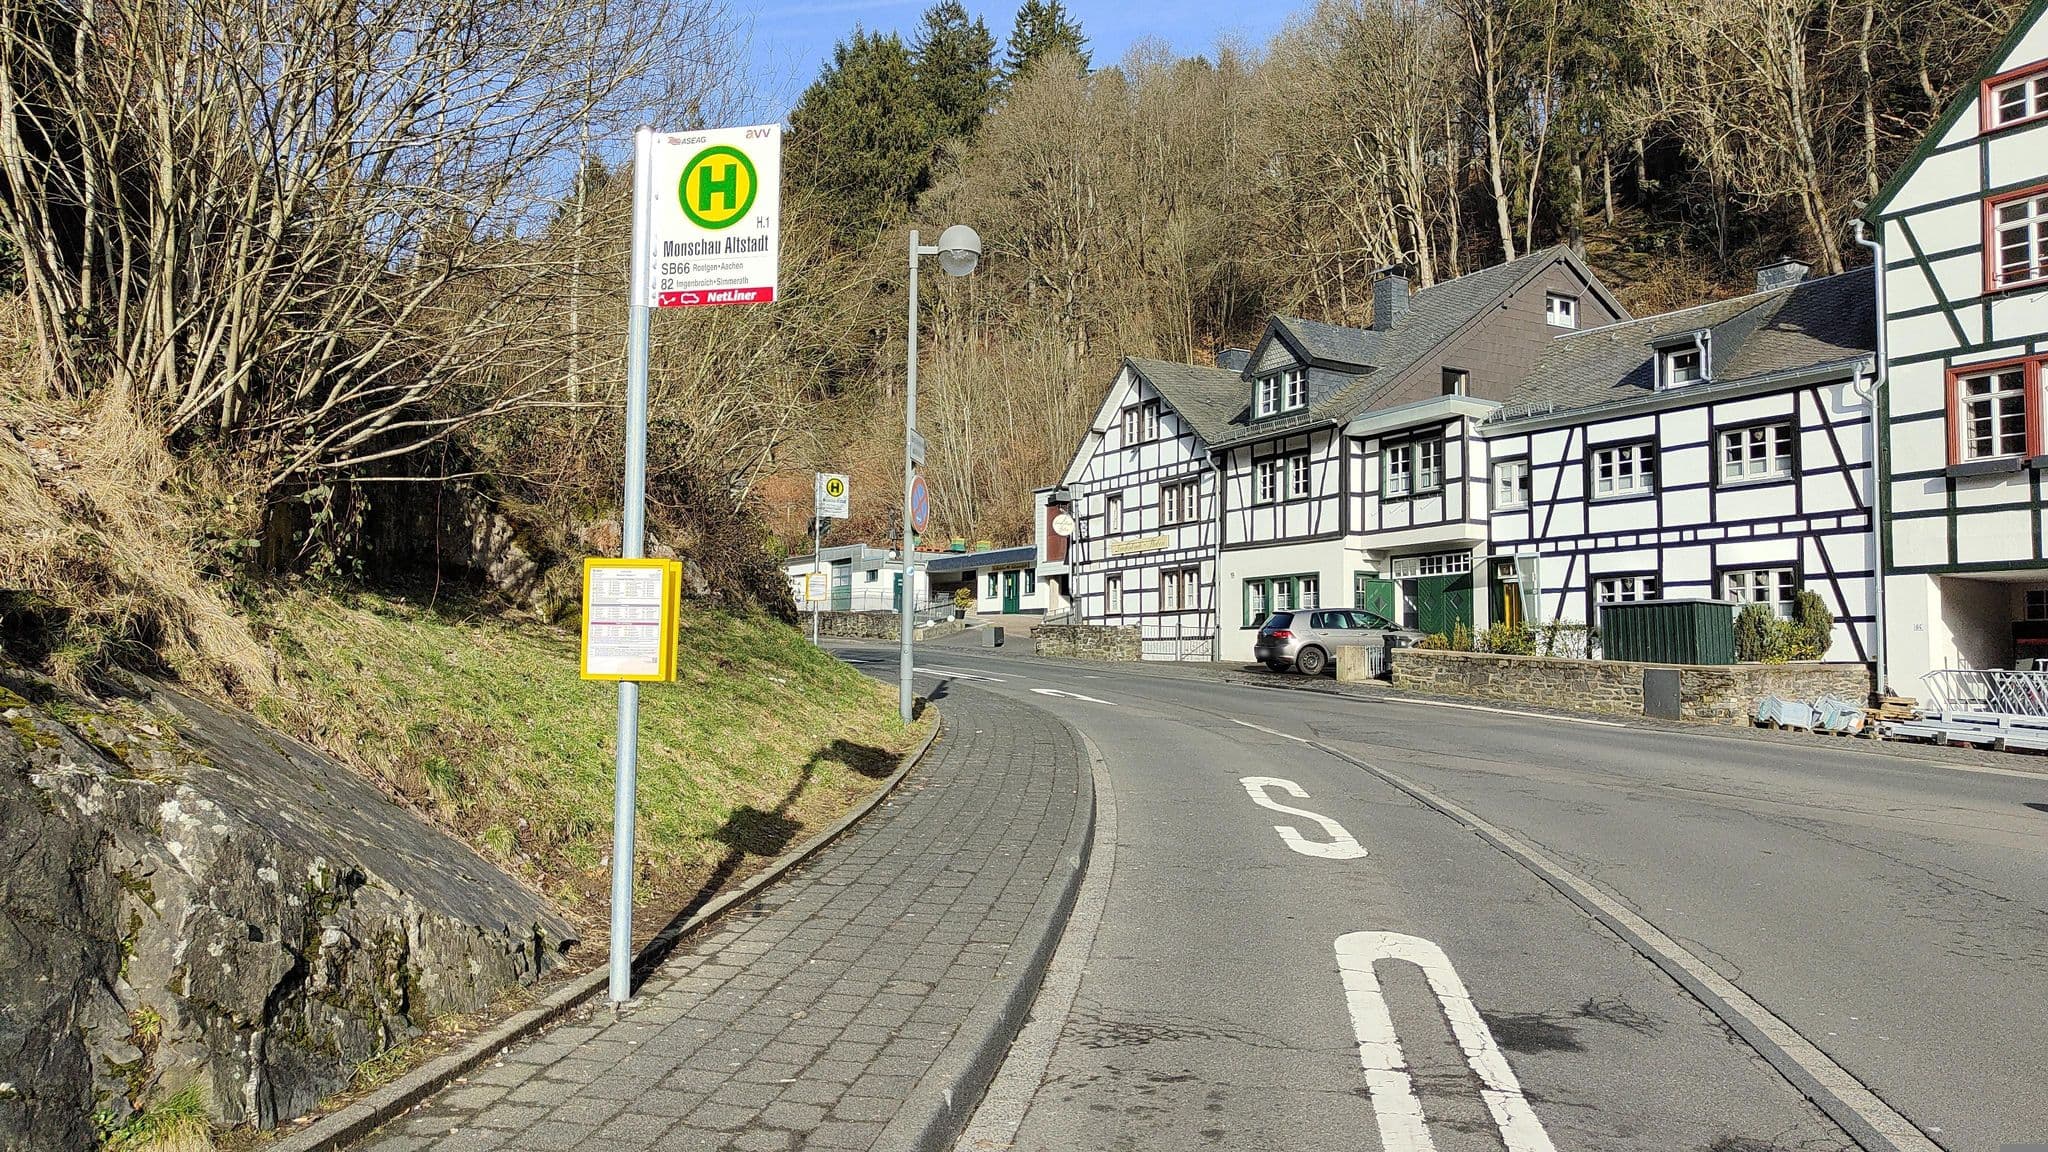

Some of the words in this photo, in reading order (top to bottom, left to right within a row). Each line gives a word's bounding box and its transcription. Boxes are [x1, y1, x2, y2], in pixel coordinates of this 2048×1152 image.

[681, 136, 707, 145] ASEAG
[698, 164, 737, 211] H
[756, 216, 770, 229] H.1
[663, 239, 721, 258] Monschau
[725, 234, 769, 254] Altstadt
[661, 262, 690, 275] SB66
[660, 278, 674, 290] 82
[707, 290, 757, 303] NetLiner
[830, 482, 840, 493] H
